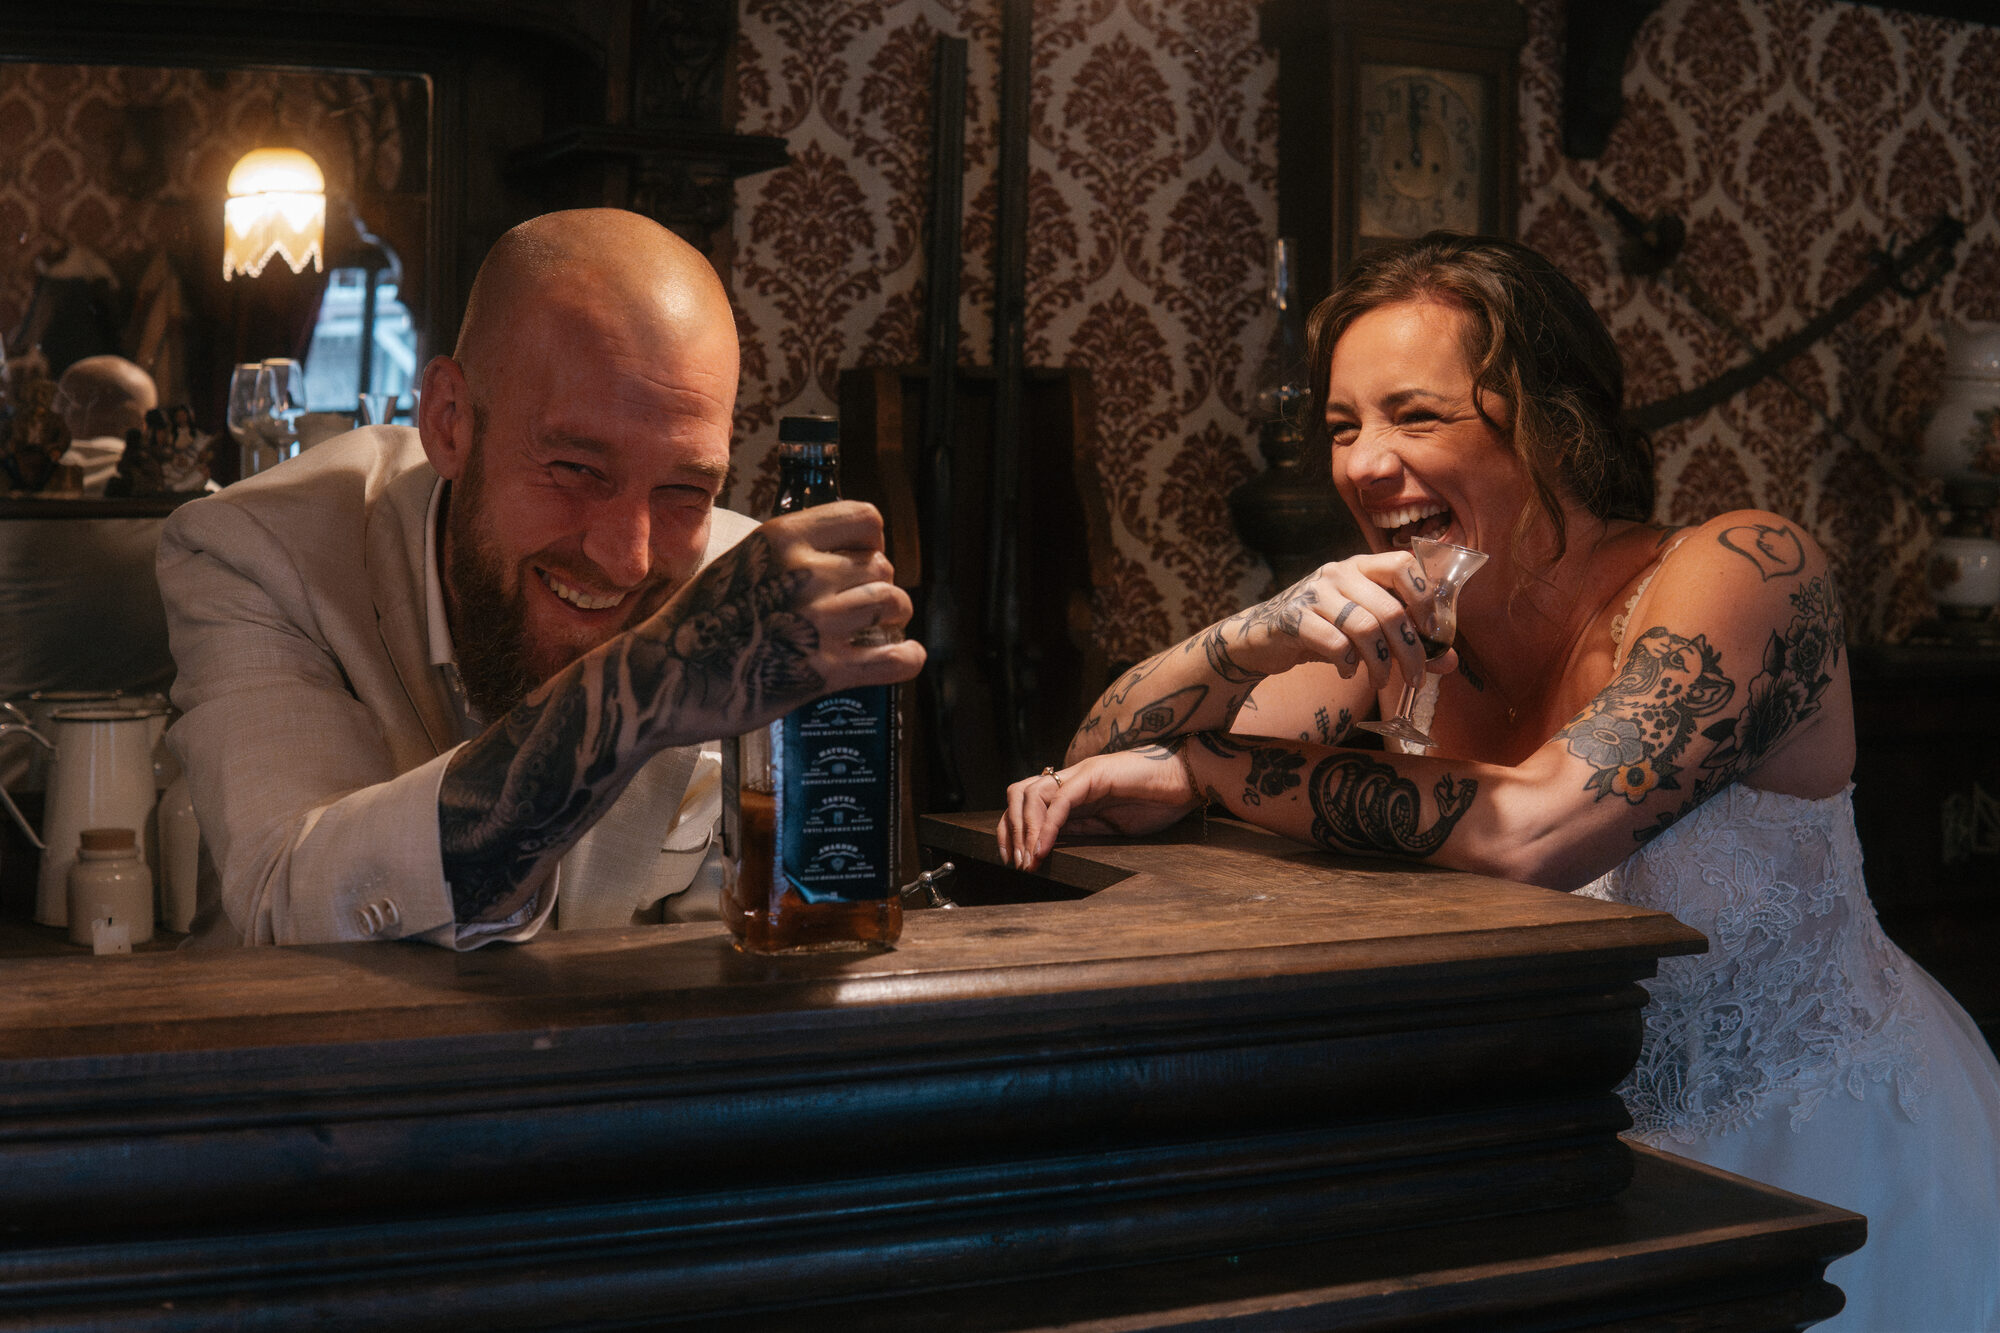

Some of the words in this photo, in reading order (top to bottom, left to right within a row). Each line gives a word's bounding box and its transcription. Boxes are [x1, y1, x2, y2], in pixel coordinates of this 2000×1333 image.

[818, 747, 860, 757] MATURED
[821, 796, 857, 805] TASTED
[819, 844, 859, 854] AWARDED
